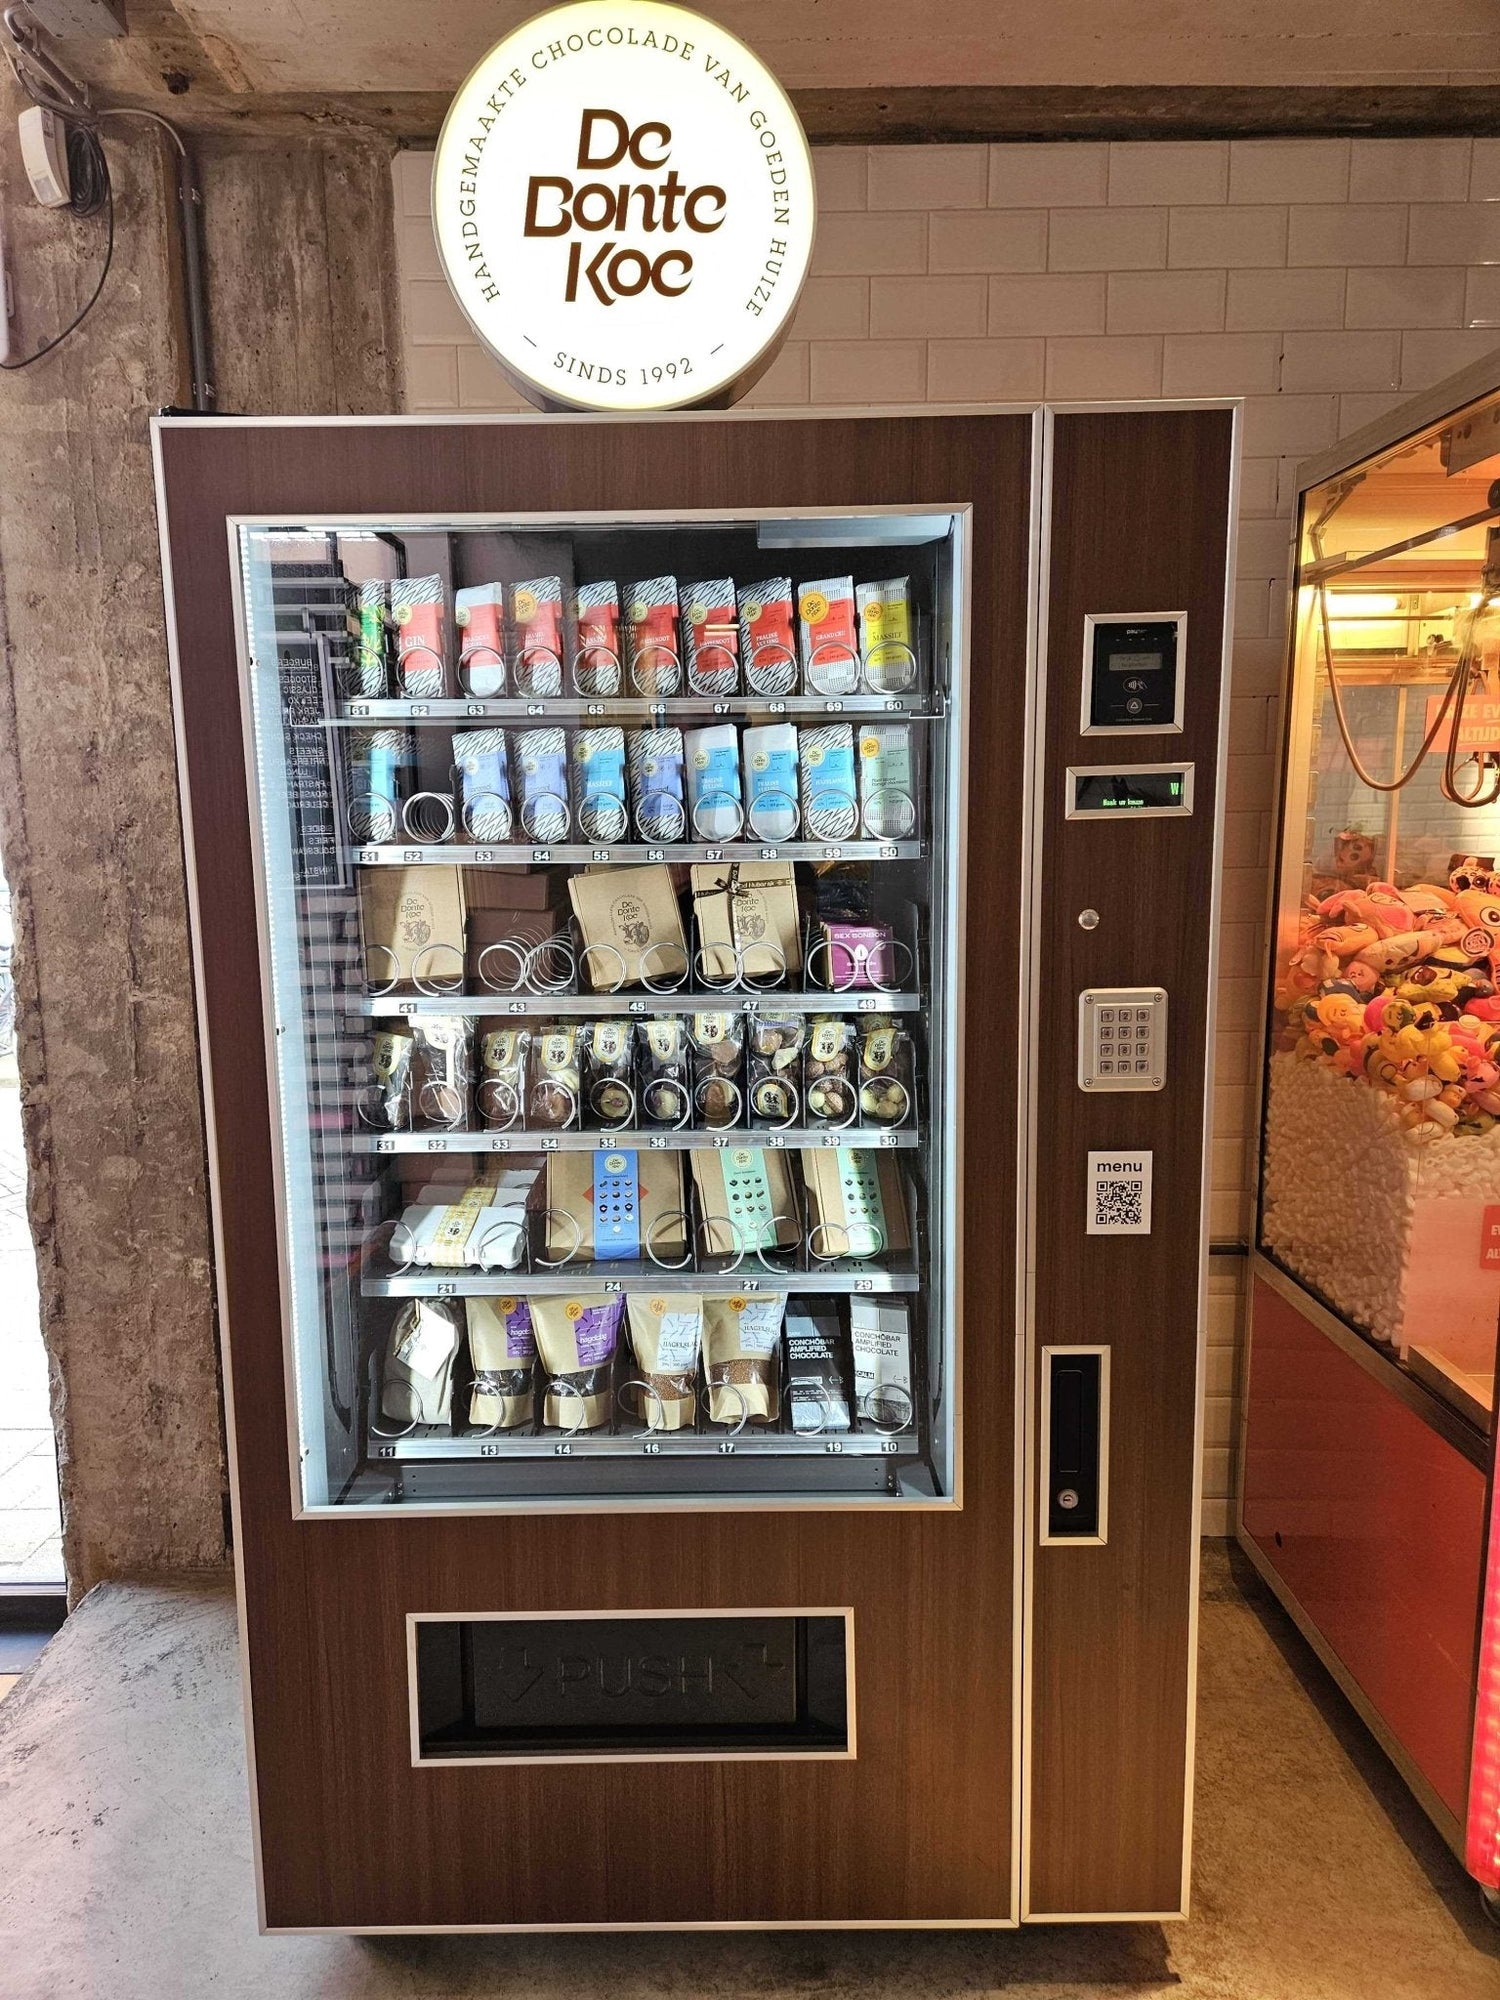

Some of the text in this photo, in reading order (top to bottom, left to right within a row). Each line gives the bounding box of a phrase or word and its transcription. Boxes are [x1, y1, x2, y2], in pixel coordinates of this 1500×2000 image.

[576, 108, 672, 170] De
[459, 27, 790, 317] HANDGEMAAKTE CHOCOLADE VAN GOEDEN HUIZE
[523, 170, 727, 237] Bonte
[565, 242, 694, 306] Koe
[553, 352, 694, 386] SINDS 1992
[405, 635, 425, 647] GIN
[351, 705, 367, 714] 61
[468, 705, 484, 715] 63
[528, 705, 544, 715] 64
[588, 705, 604, 715] 65
[650, 705, 665, 714] 66
[714, 704, 729, 713] 67
[769, 703, 785, 712] 68
[826, 702, 842, 711] 69
[886, 701, 902, 710] 60
[411, 706, 427, 715] 62
[361, 852, 375, 861] 51
[405, 852, 421, 860] 52
[476, 852, 491, 860] 53
[534, 852, 550, 860] 54
[593, 851, 608, 860] 55
[648, 851, 664, 860] 56
[706, 850, 722, 859] 57
[762, 850, 777, 858] 58
[825, 849, 840, 857] 59
[881, 848, 897, 856] 50
[400, 1004, 415, 1013] 41
[510, 1003, 525, 1012] 43
[629, 1002, 646, 1011] 45
[742, 1001, 758, 1011] 47
[859, 1000, 875, 1009] 49
[429, 1141, 445, 1149] 32
[493, 1140, 509, 1149] 33
[542, 1139, 557, 1148] 34
[601, 1138, 615, 1147] 35
[651, 1138, 666, 1147] 36
[714, 1137, 728, 1146] 37
[770, 1137, 784, 1146] 38
[825, 1137, 840, 1145] 39
[882, 1136, 897, 1145] 30
[378, 1141, 392, 1150] 31
[1097, 1162, 1142, 1172] menu
[438, 1284, 453, 1293] 21
[606, 1283, 621, 1291] 24
[743, 1281, 758, 1290] 27
[856, 1281, 871, 1289] 29
[855, 1338, 892, 1348] AMPLIFIED
[855, 1345, 899, 1356] CHOCOLATE
[790, 1352, 833, 1360] CHOCOLATE
[483, 1446, 497, 1454] 13
[556, 1445, 571, 1453] 14
[645, 1444, 659, 1453] 16
[720, 1443, 734, 1452] 17
[827, 1443, 841, 1451] 19
[883, 1442, 897, 1451] 10
[380, 1448, 394, 1456] 11
[559, 1655, 713, 1697] PUSH
